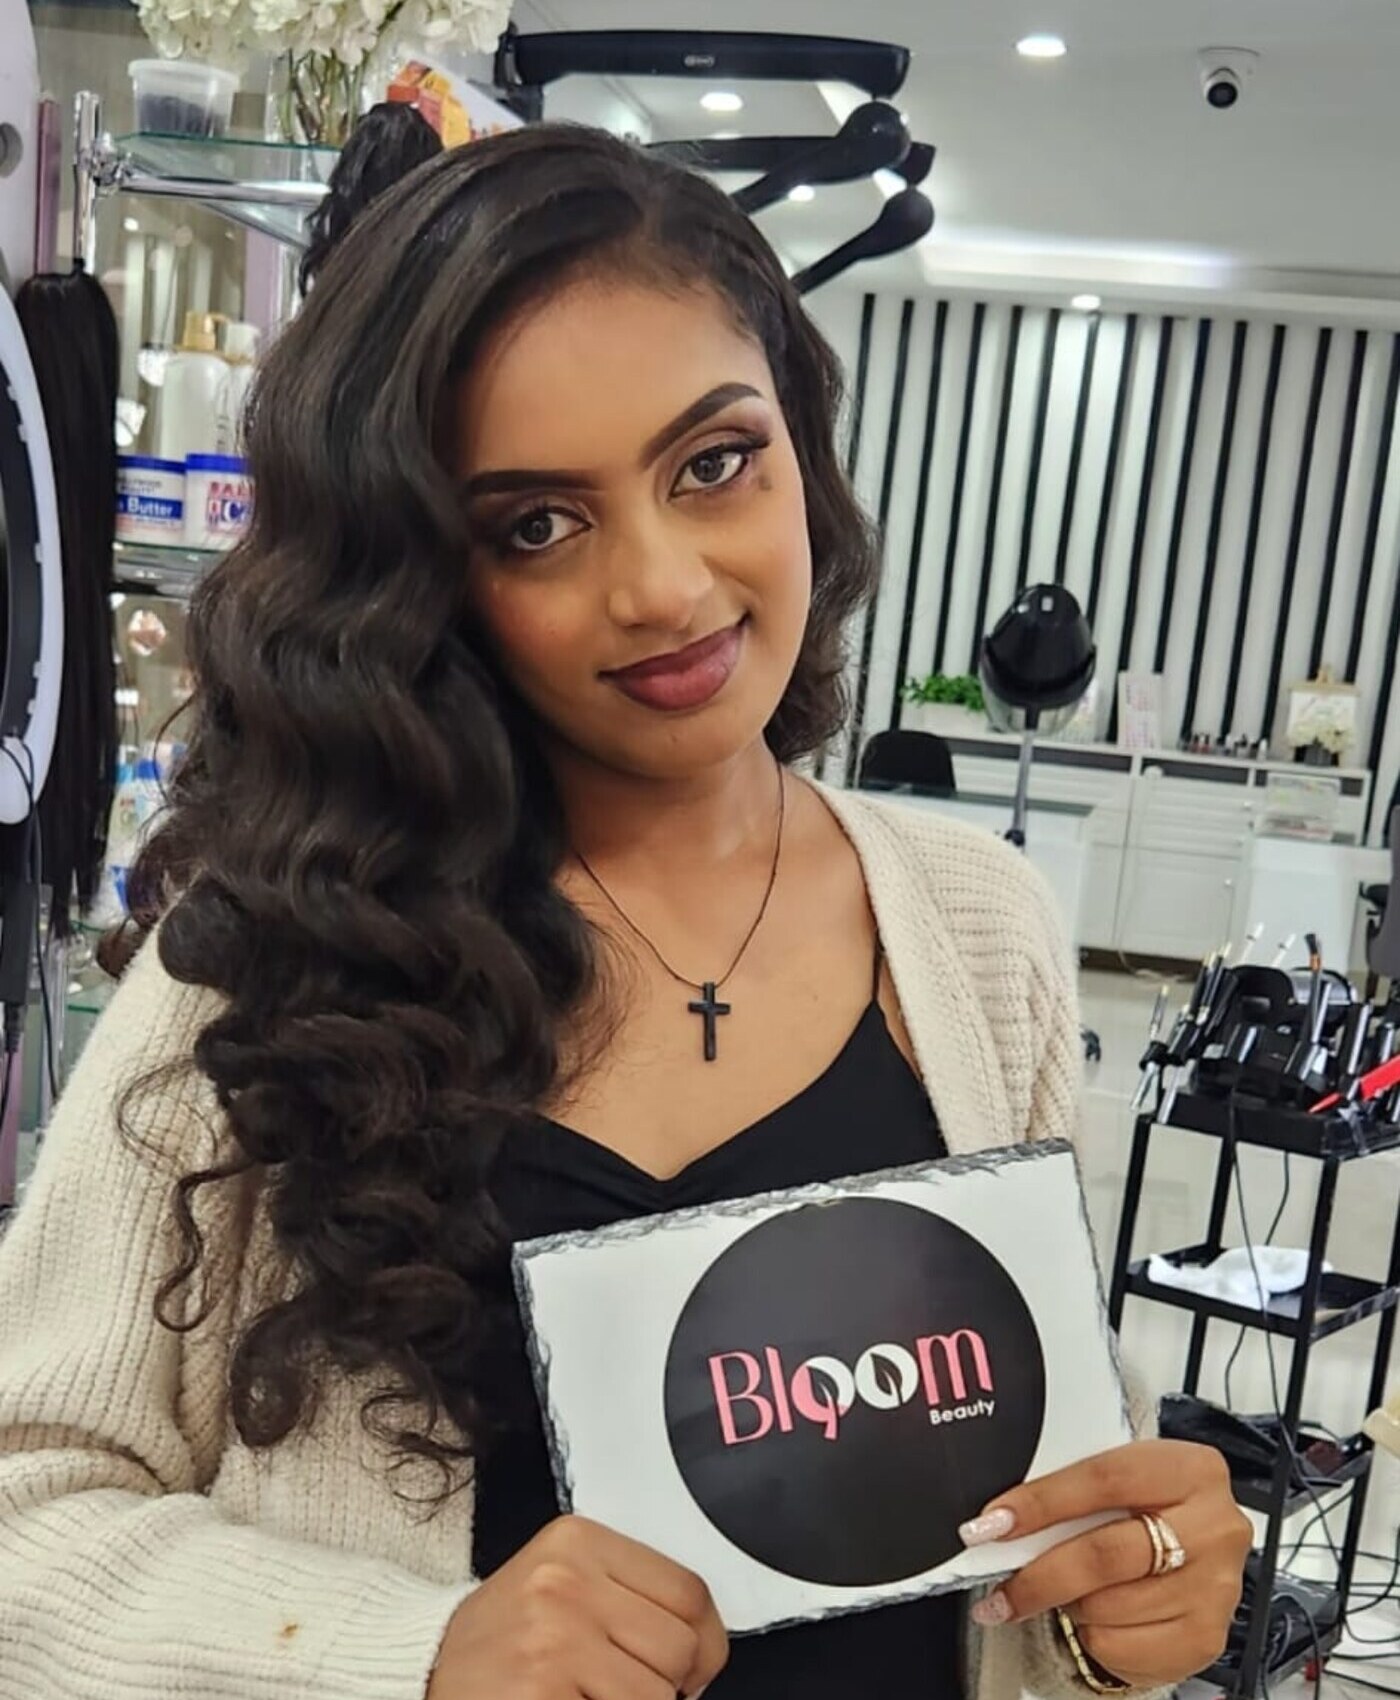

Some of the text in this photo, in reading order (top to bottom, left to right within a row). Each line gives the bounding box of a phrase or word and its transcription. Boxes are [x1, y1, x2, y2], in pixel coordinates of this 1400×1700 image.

[127, 496, 174, 517] Butter
[708, 1329, 994, 1445] Bloom
[929, 1399, 996, 1426] Beauty
